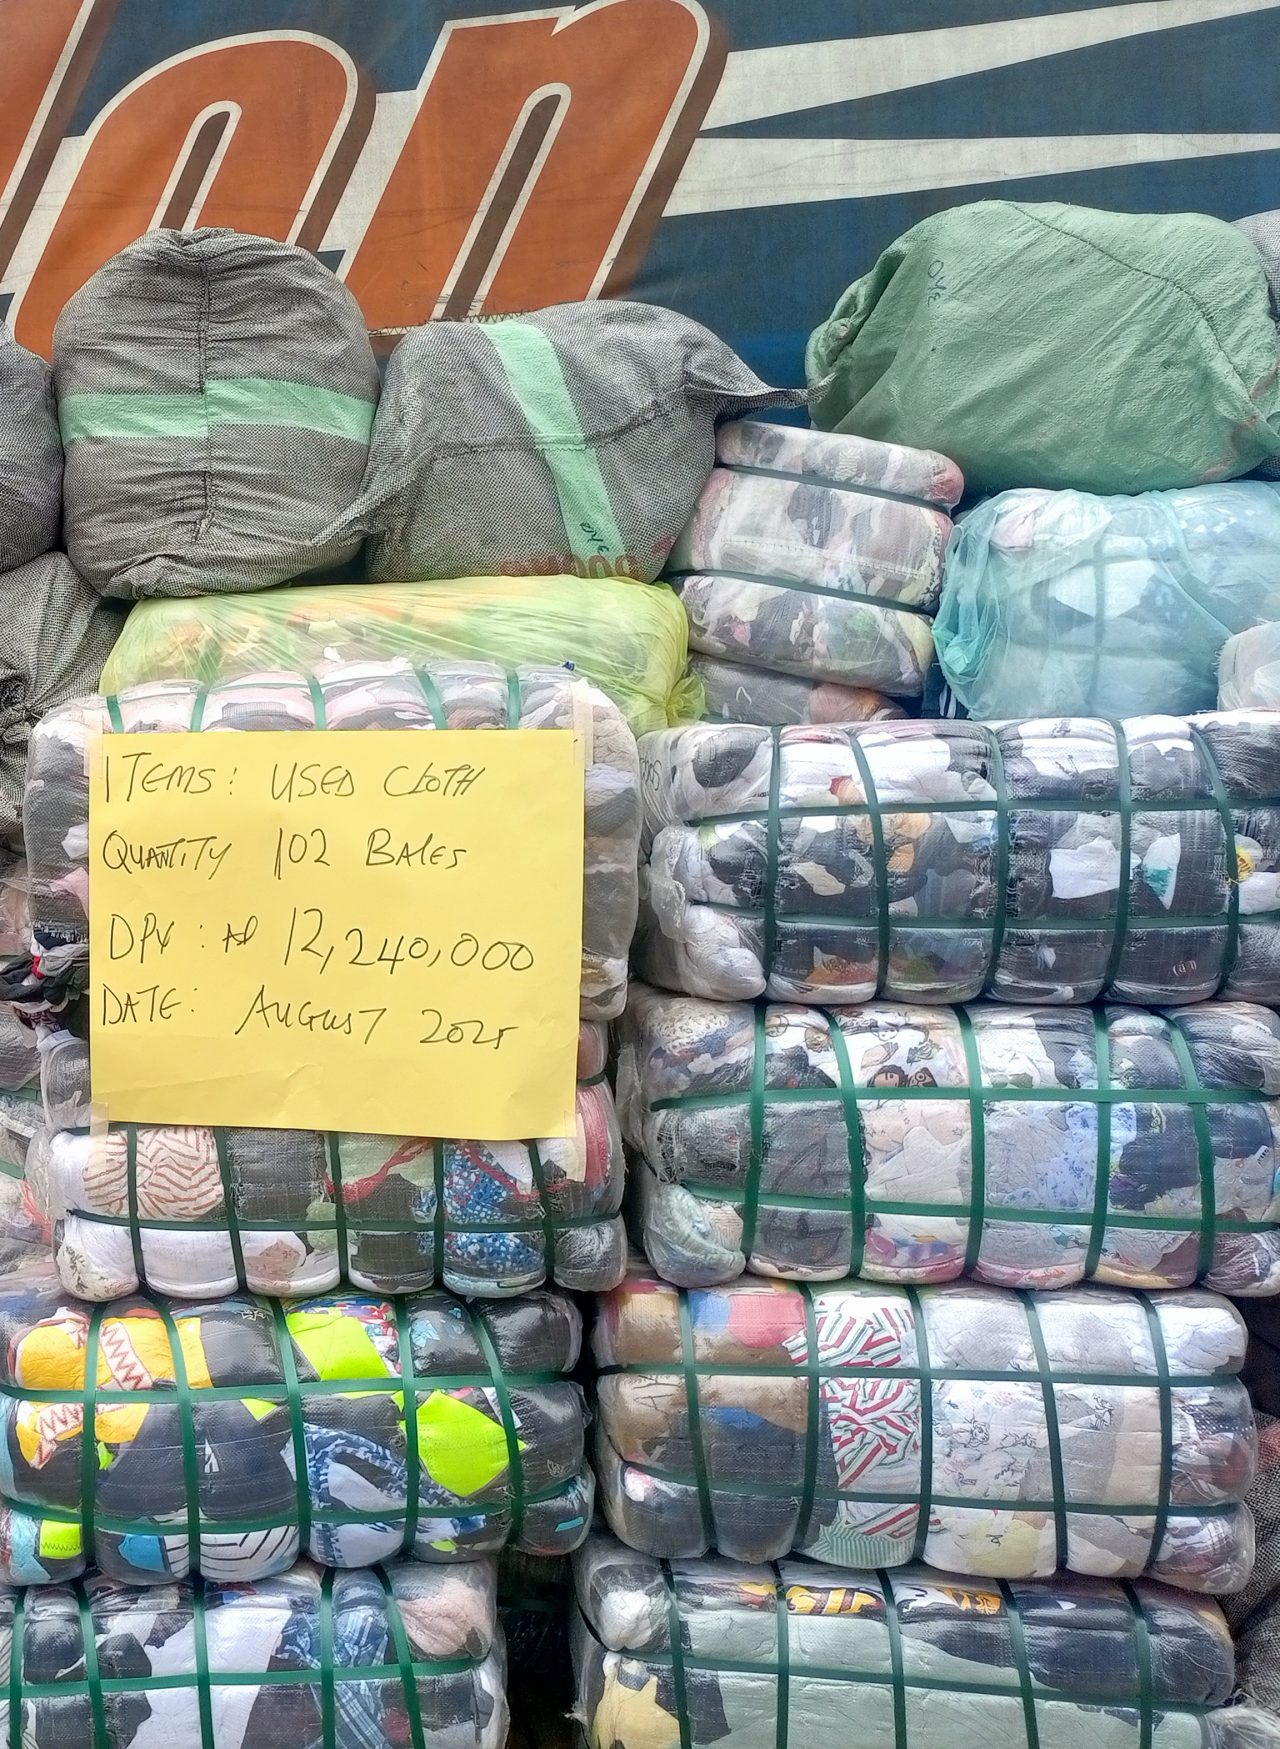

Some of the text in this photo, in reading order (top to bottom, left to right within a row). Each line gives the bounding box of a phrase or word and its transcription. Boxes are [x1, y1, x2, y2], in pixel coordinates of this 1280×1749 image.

[271, 762, 355, 799] USED
[384, 761, 487, 798] CLOTH
[102, 829, 233, 880] QUANTITY
[273, 826, 331, 881] 102
[283, 908, 535, 976] 12,240,000
[101, 983, 520, 1051] DATE: AUGUST 2025
